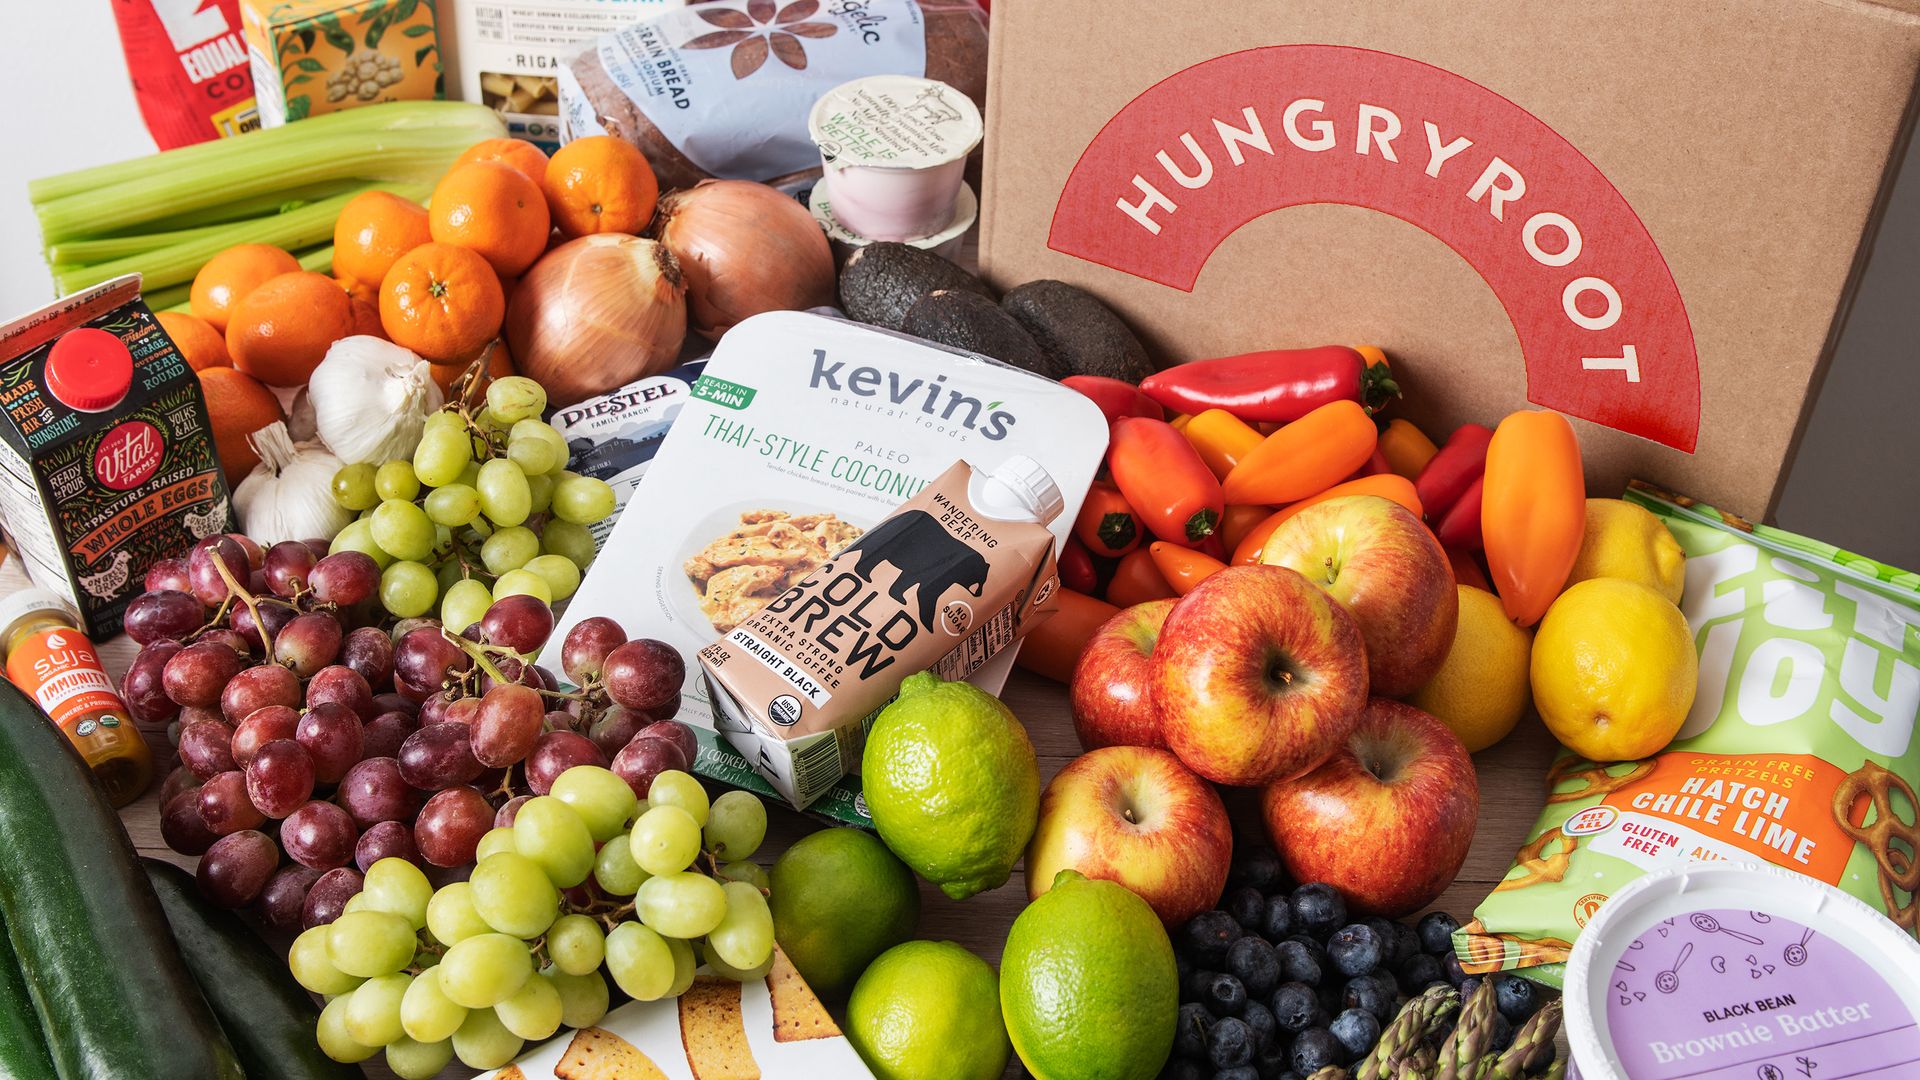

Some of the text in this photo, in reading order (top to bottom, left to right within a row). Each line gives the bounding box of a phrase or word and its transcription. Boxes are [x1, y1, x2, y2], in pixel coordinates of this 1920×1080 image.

[516, 54, 559, 68] RIGA
[640, 59, 665, 95] SODIUM
[657, 59, 690, 109] BREAD
[821, 123, 875, 160] BETTER
[830, 112, 898, 160] WHOLE IS
[1115, 98, 1642, 383] HUNGRYROOT
[121, 323, 157, 346] Freedom
[138, 337, 149, 345] TO
[134, 346, 174, 368] OUTDOORS
[143, 353, 180, 375] YEAR
[143, 363, 185, 391] ROUND
[703, 378, 748, 397] READY IN
[0, 379, 37, 405] MADE
[6, 390, 40, 410] WITH
[697, 385, 744, 407] 5-MIN
[809, 349, 1016, 442] kevin's
[11, 397, 46, 422] FRESH
[169, 405, 197, 427] YOLKS
[561, 383, 677, 429] DIESTEL
[21, 417, 43, 435] AIR
[29, 412, 81, 448] SUNSHINE
[175, 419, 198, 437] & ALL
[591, 416, 620, 429] FAMILY
[915, 415, 967, 443] foods
[98, 426, 154, 483] Vital
[704, 413, 929, 499] THAI-STYLE COCONU
[854, 441, 910, 465] PALEO
[49, 463, 81, 490] READY
[123, 456, 155, 485] FARMS
[151, 467, 194, 490] RAISED
[766, 462, 787, 474] Tender
[787, 469, 810, 482] chicken
[846, 487, 866, 499] paired
[867, 494, 880, 502] with
[54, 477, 86, 498] to POUR
[84, 499, 157, 554] WHOLE
[161, 479, 208, 510] EGGS
[158, 518, 174, 532] ACID
[189, 510, 219, 525] UNDER
[586, 521, 604, 530] alories
[933, 493, 998, 548] WANDERING
[940, 513, 972, 540] BEAR
[88, 560, 125, 587] ON GREEN
[95, 570, 127, 595] GRASS
[798, 563, 919, 651] COLD
[956, 607, 967, 620] NO
[943, 605, 966, 635] SUGAR
[761, 614, 843, 675] EXTRA STRONG
[765, 587, 896, 681] BREW
[715, 645, 731, 662] FL OZ
[733, 631, 821, 699] STRAIGHT BLACK
[747, 619, 841, 689] ORGANIC COFFEE
[40, 664, 70, 681] ORGANIC
[44, 672, 108, 701] IMMUNITY
[76, 695, 95, 703] WITH
[56, 706, 84, 725] TURMERIC
[773, 703, 790, 723] ORGANIC
[780, 699, 797, 716] USDA
[707, 749, 748, 773] COOKED,
[1691, 759, 1815, 781] GRAIN FREE
[1696, 766, 1794, 789] PRETZELS
[1680, 777, 1790, 820] HATCH
[1574, 822, 1602, 831] ALL
[1580, 812, 1606, 821] FIT
[1632, 792, 1816, 865] CHILE LIME
[1621, 822, 1680, 848] GLUTEN
[1622, 836, 1661, 857] FREE
[1703, 993, 1797, 1024] BLACK BEAN
[1649, 1002, 1873, 1065] Brownie Batter
